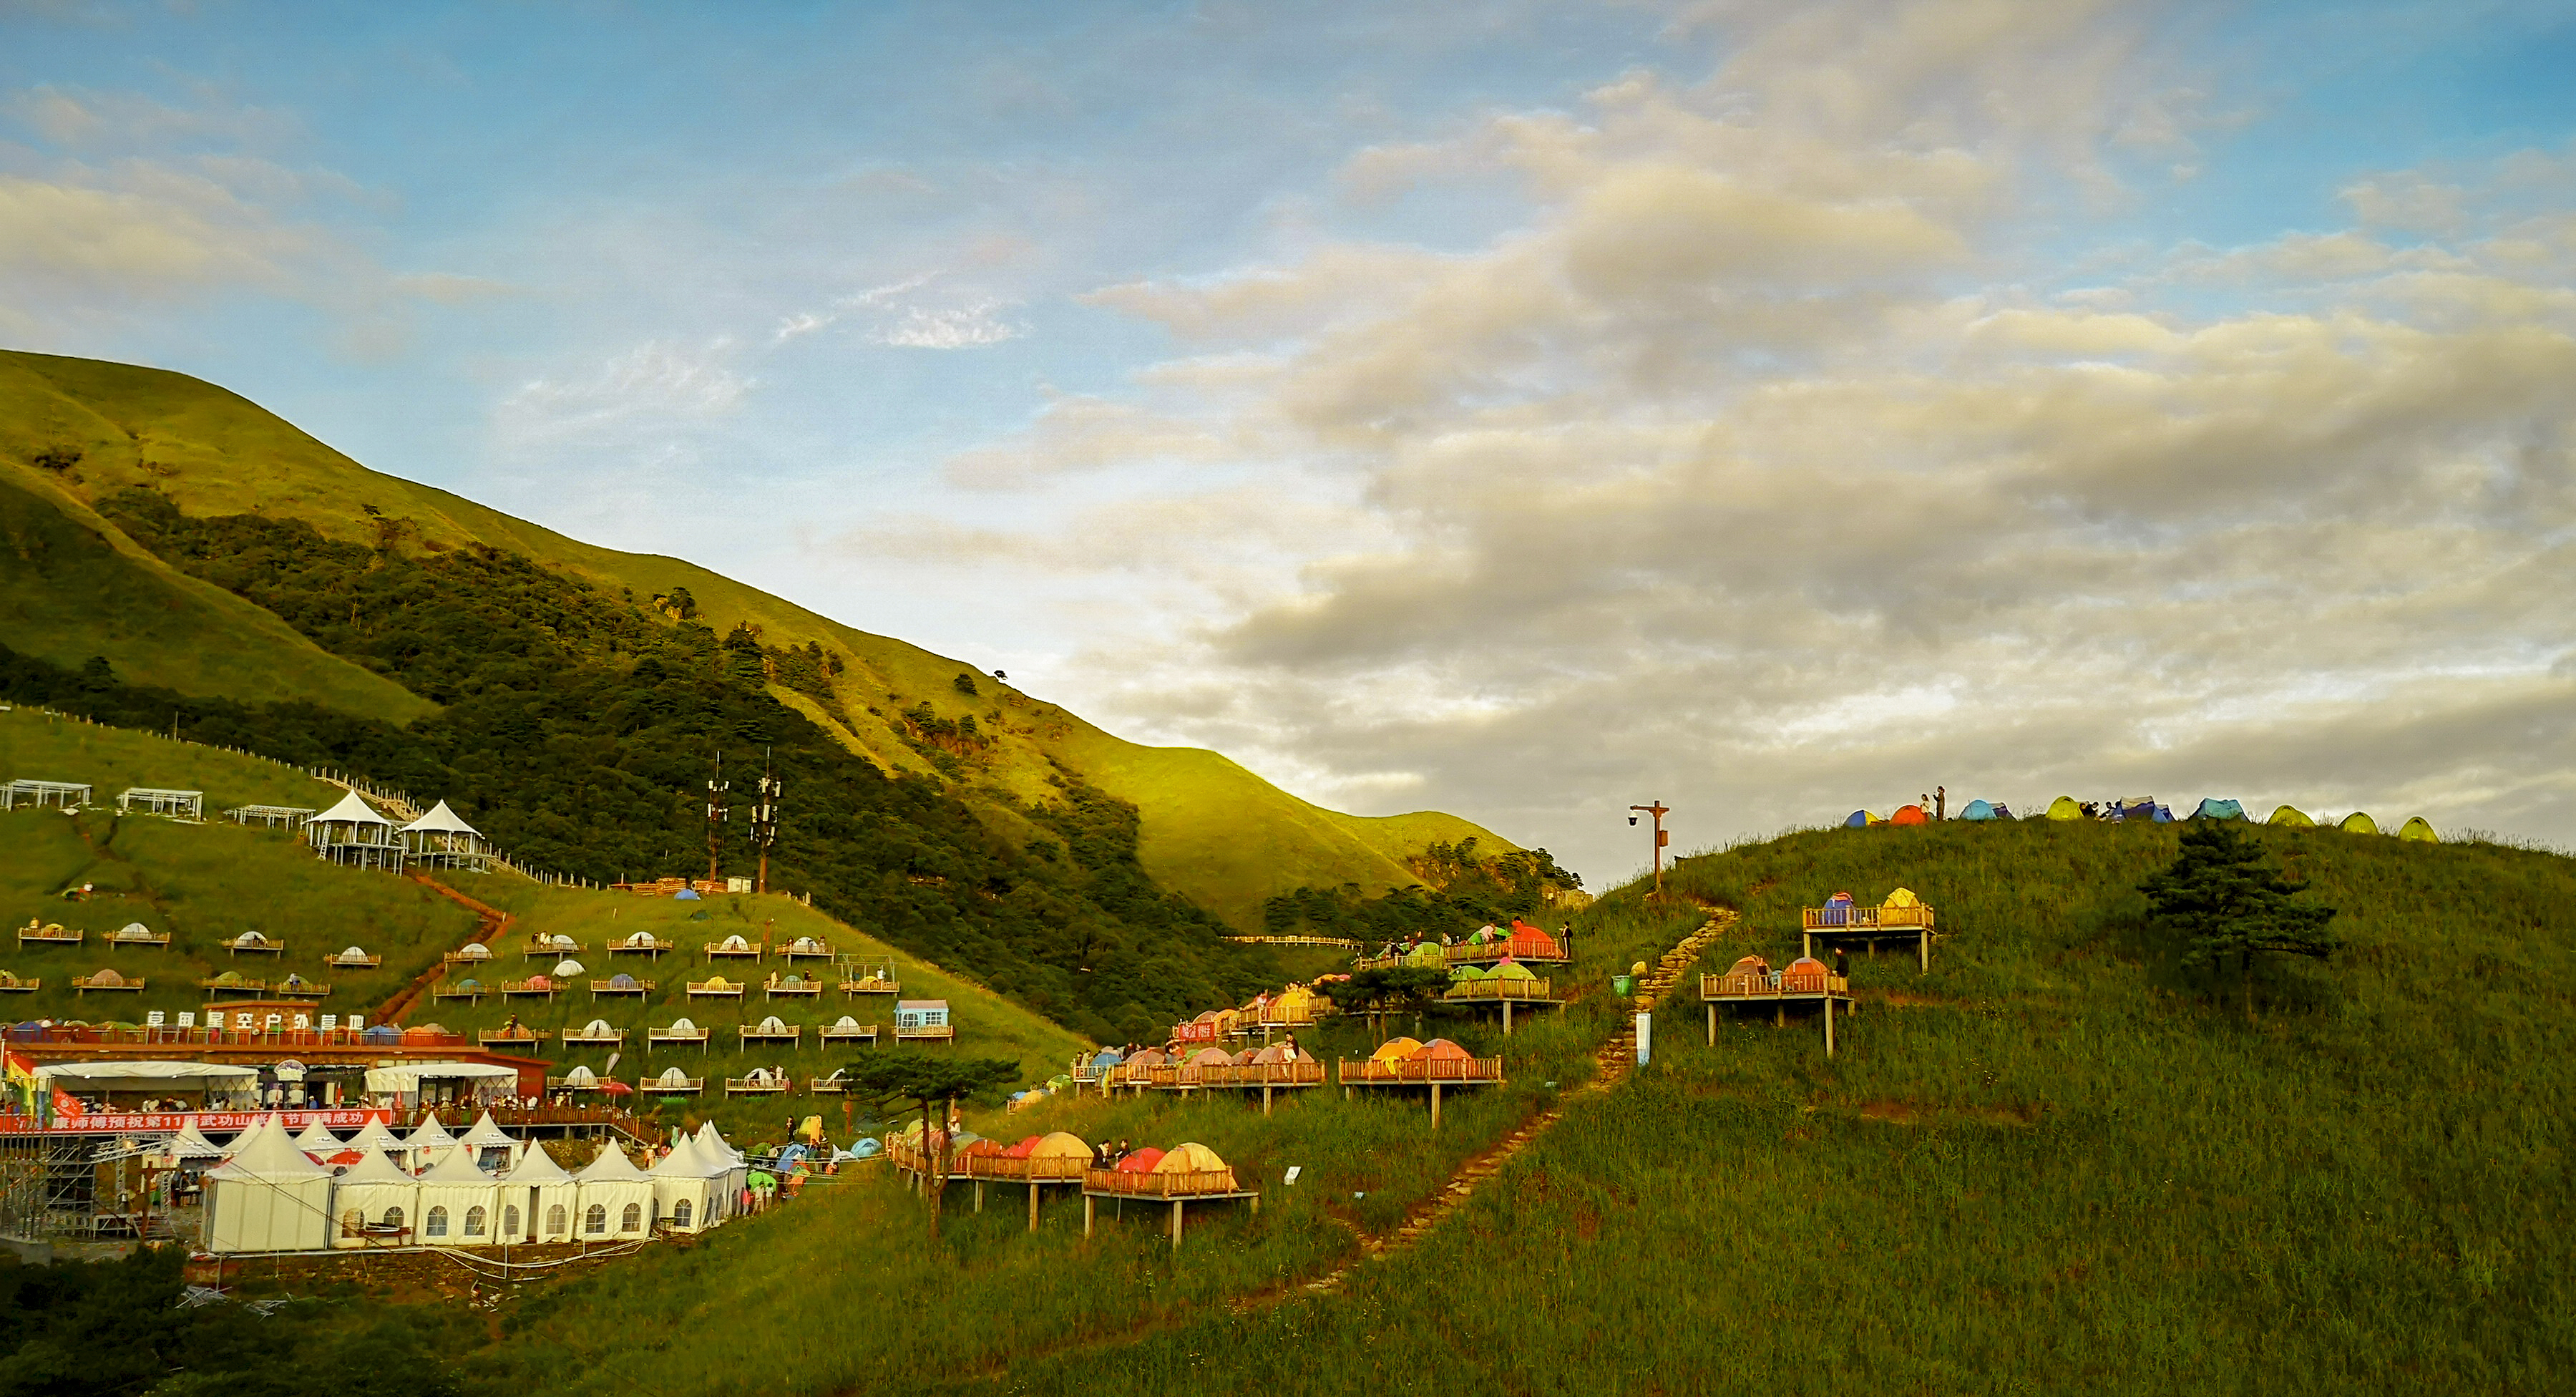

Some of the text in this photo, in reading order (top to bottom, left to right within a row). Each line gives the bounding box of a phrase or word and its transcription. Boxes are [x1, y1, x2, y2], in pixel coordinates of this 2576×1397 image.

[147, 1011, 364, 1030] 草甸星空户外营地
